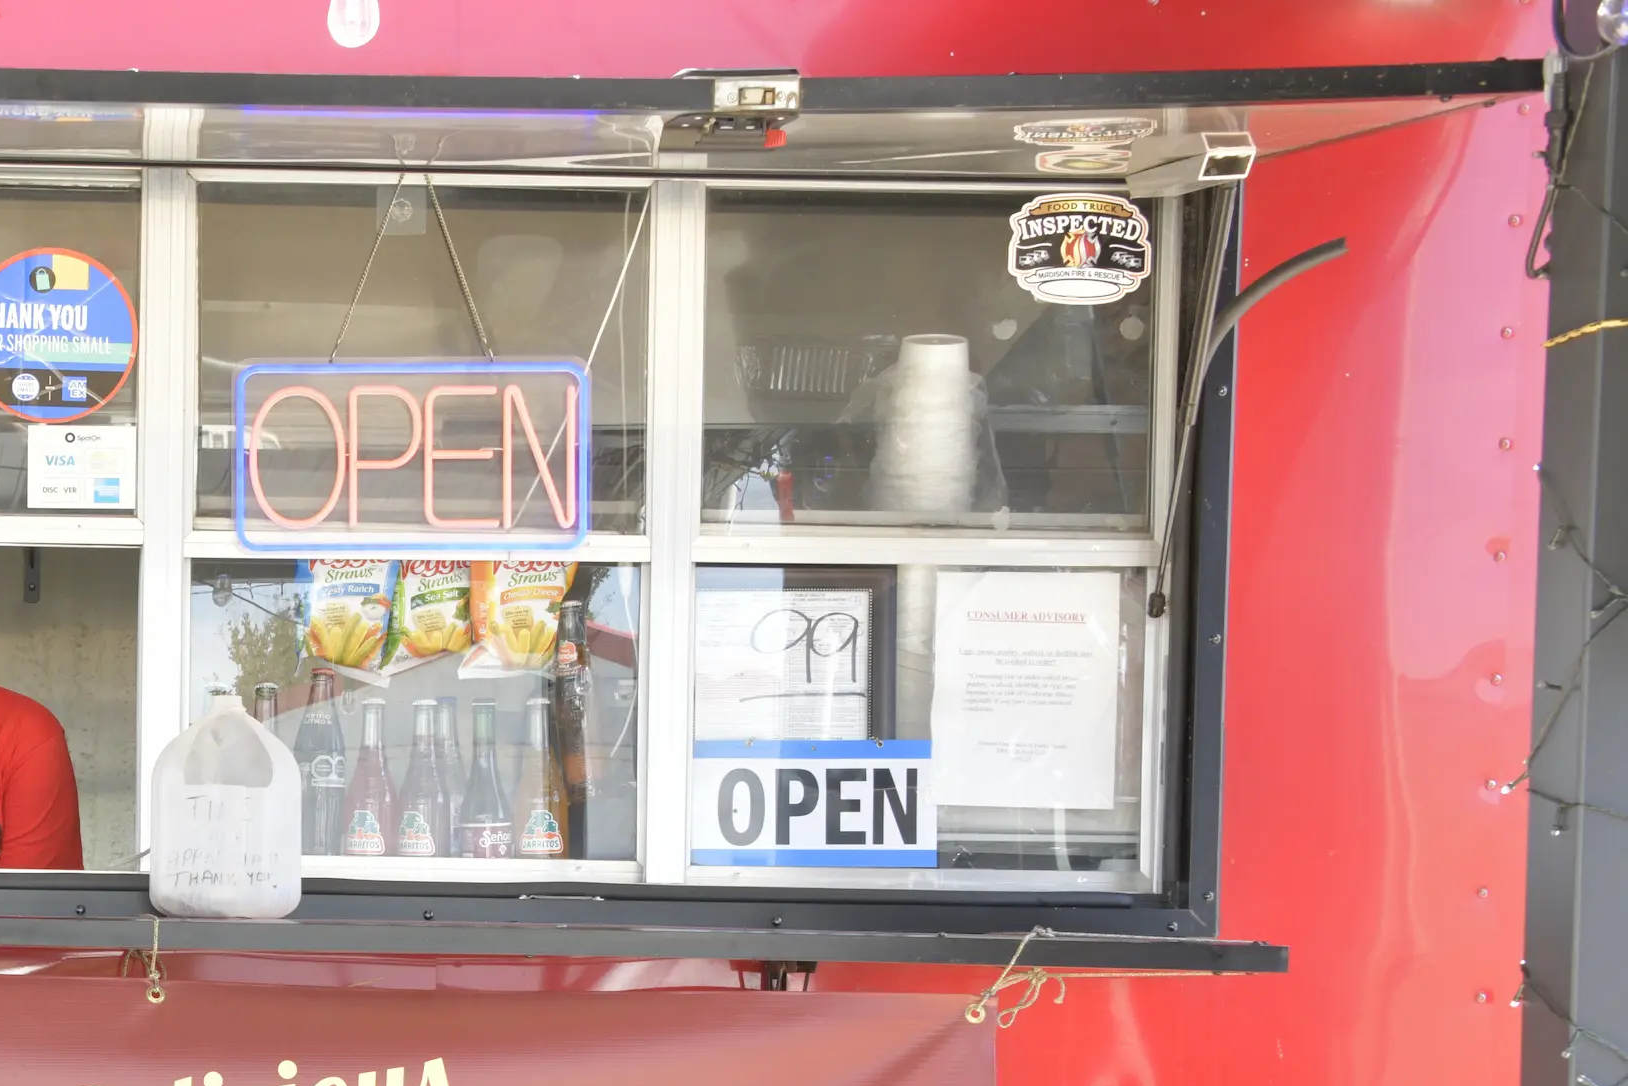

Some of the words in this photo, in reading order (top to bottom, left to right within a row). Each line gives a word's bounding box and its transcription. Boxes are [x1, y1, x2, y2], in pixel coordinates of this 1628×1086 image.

[1047, 202, 1078, 211] FOOD
[1082, 202, 1117, 213] TRUCK
[1019, 215, 1142, 241] INSPECTED
[1038, 271, 1070, 279] MADISON
[1072, 270, 1084, 278] FIRE
[1094, 272, 1121, 281] RESCUE
[49, 305, 87, 330] YOU
[6, 334, 68, 353] SHOPPING
[73, 337, 111, 355] SMALL
[45, 455, 75, 466] VISA
[249, 385, 576, 530] OPEN
[325, 568, 373, 583] Straws
[508, 572, 557, 587] Straws
[348, 585, 374, 593] Ranch
[418, 574, 462, 593] Straws
[425, 593, 440, 601] Sea
[444, 589, 459, 598] Salt
[967, 611, 1028, 621] CONSUMER
[1031, 612, 1086, 622] ADVISORY
[717, 767, 918, 848] OPEN
[523, 840, 558, 848] JARRITOS
